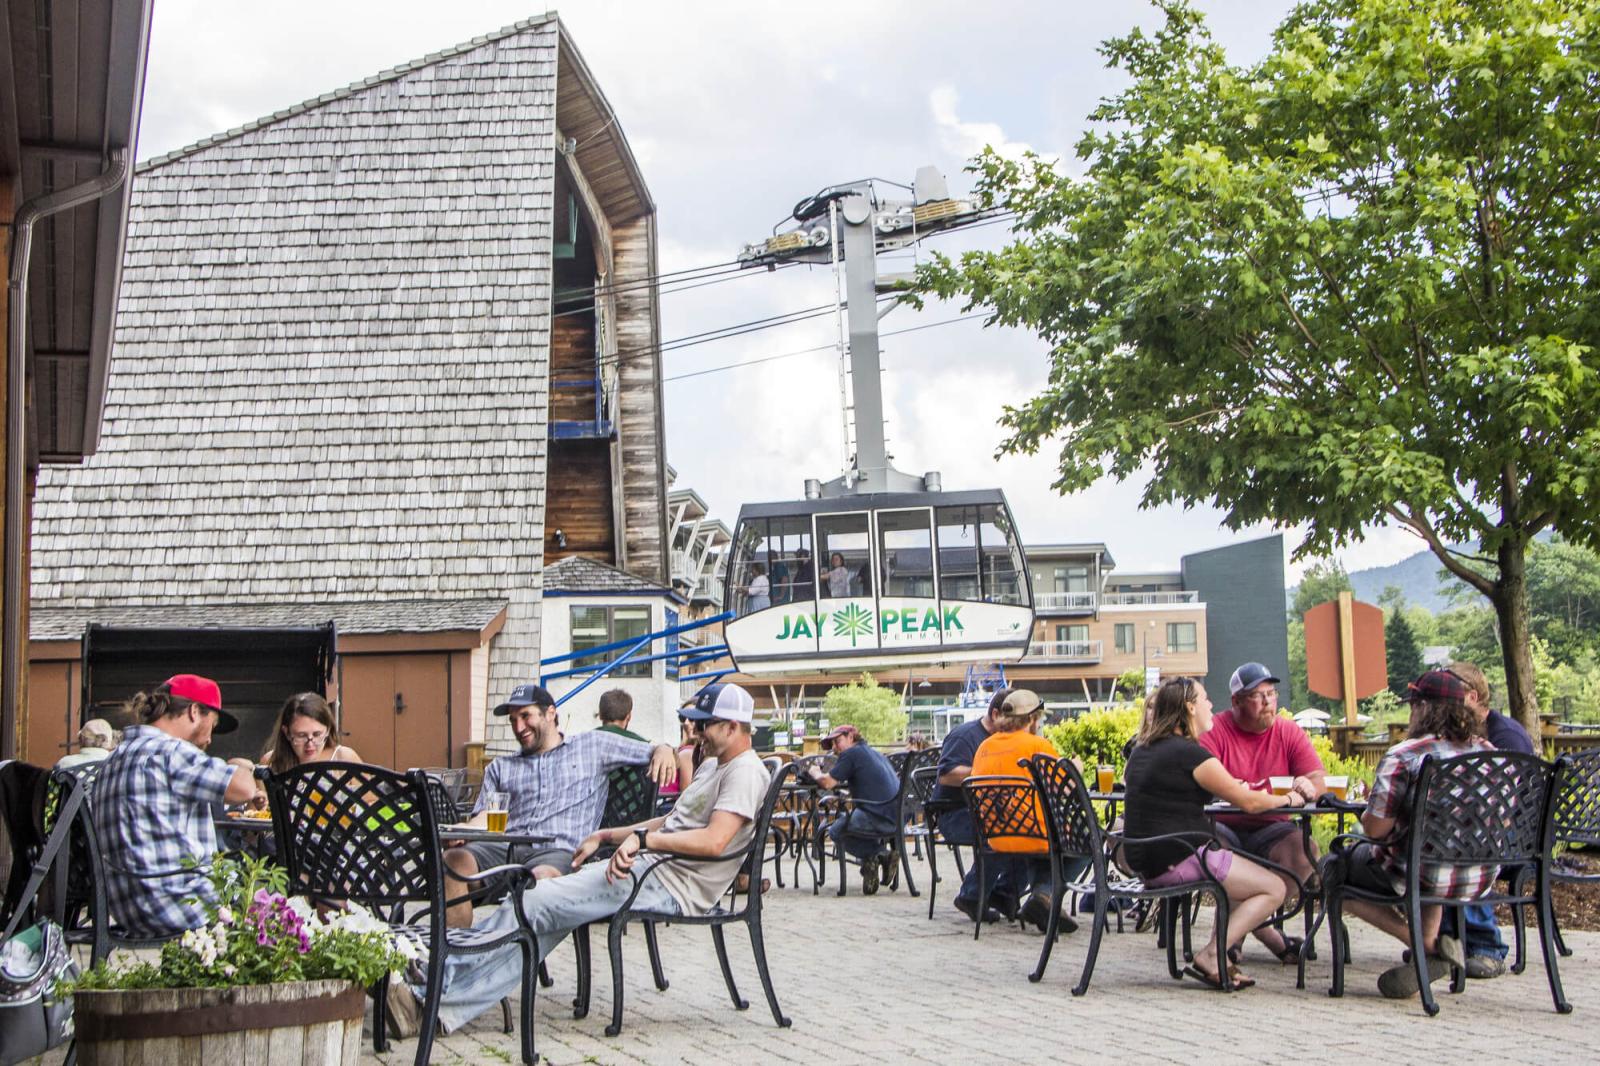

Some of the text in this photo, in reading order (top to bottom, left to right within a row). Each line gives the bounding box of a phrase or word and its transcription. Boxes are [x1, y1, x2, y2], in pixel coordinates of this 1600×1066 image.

[776, 605, 964, 640] JAY PEAK
[882, 631, 964, 641] VERMONT
